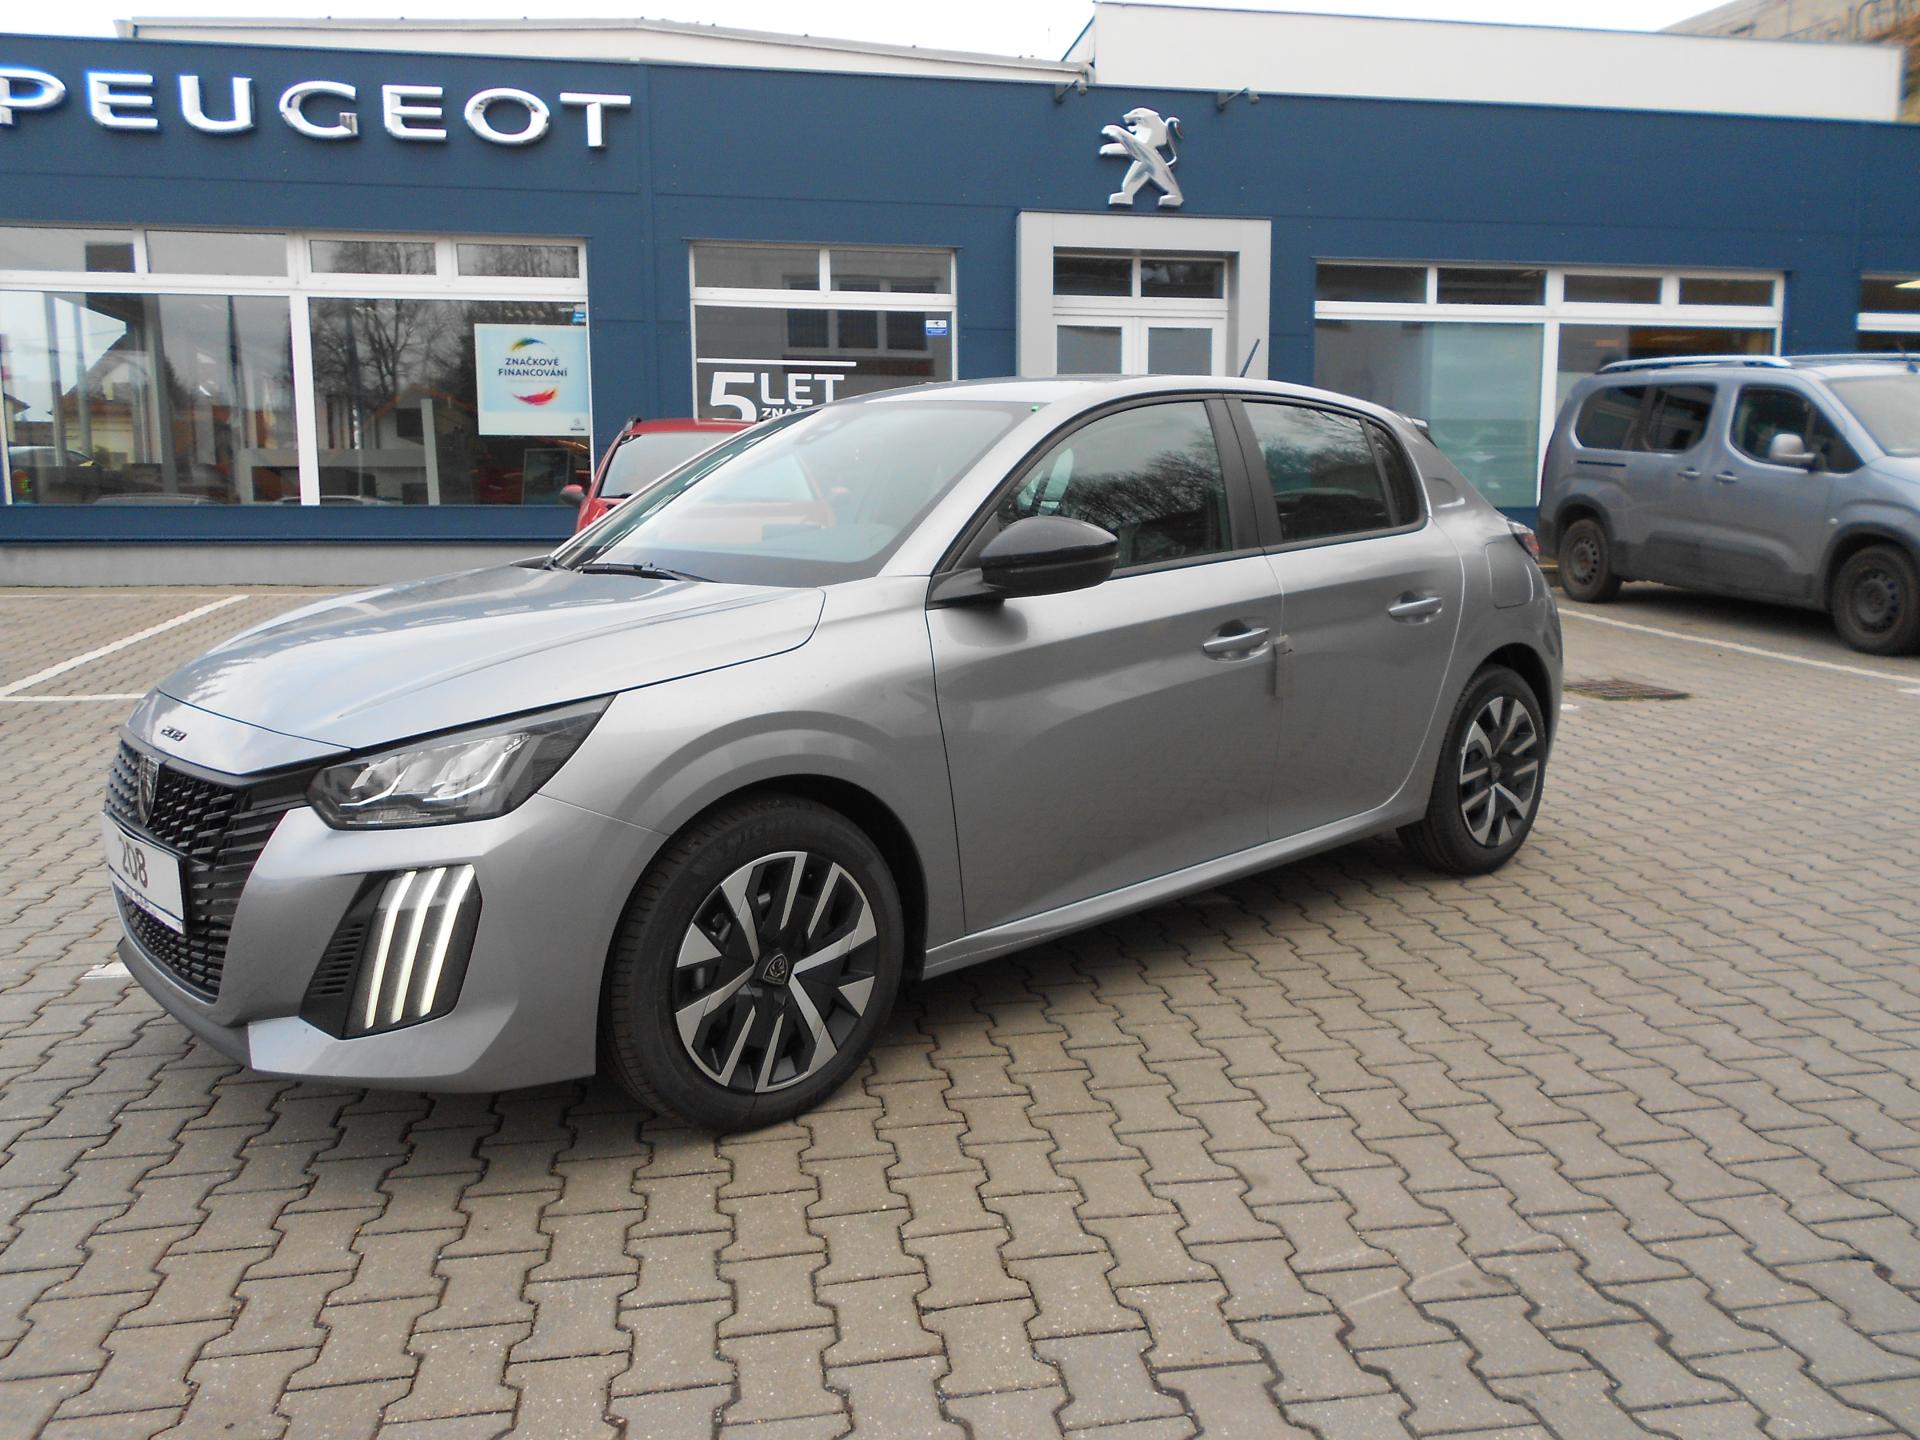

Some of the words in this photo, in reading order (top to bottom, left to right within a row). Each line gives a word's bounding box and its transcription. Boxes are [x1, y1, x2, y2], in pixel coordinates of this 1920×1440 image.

[0, 67, 632, 149] PEUGEOT
[498, 367, 568, 377] FINANCOVÁNÍ
[505, 356, 560, 366] ZNAČKOVÉ
[710, 371, 757, 422] 5
[760, 372, 845, 405] LET
[118, 834, 148, 888] 208
